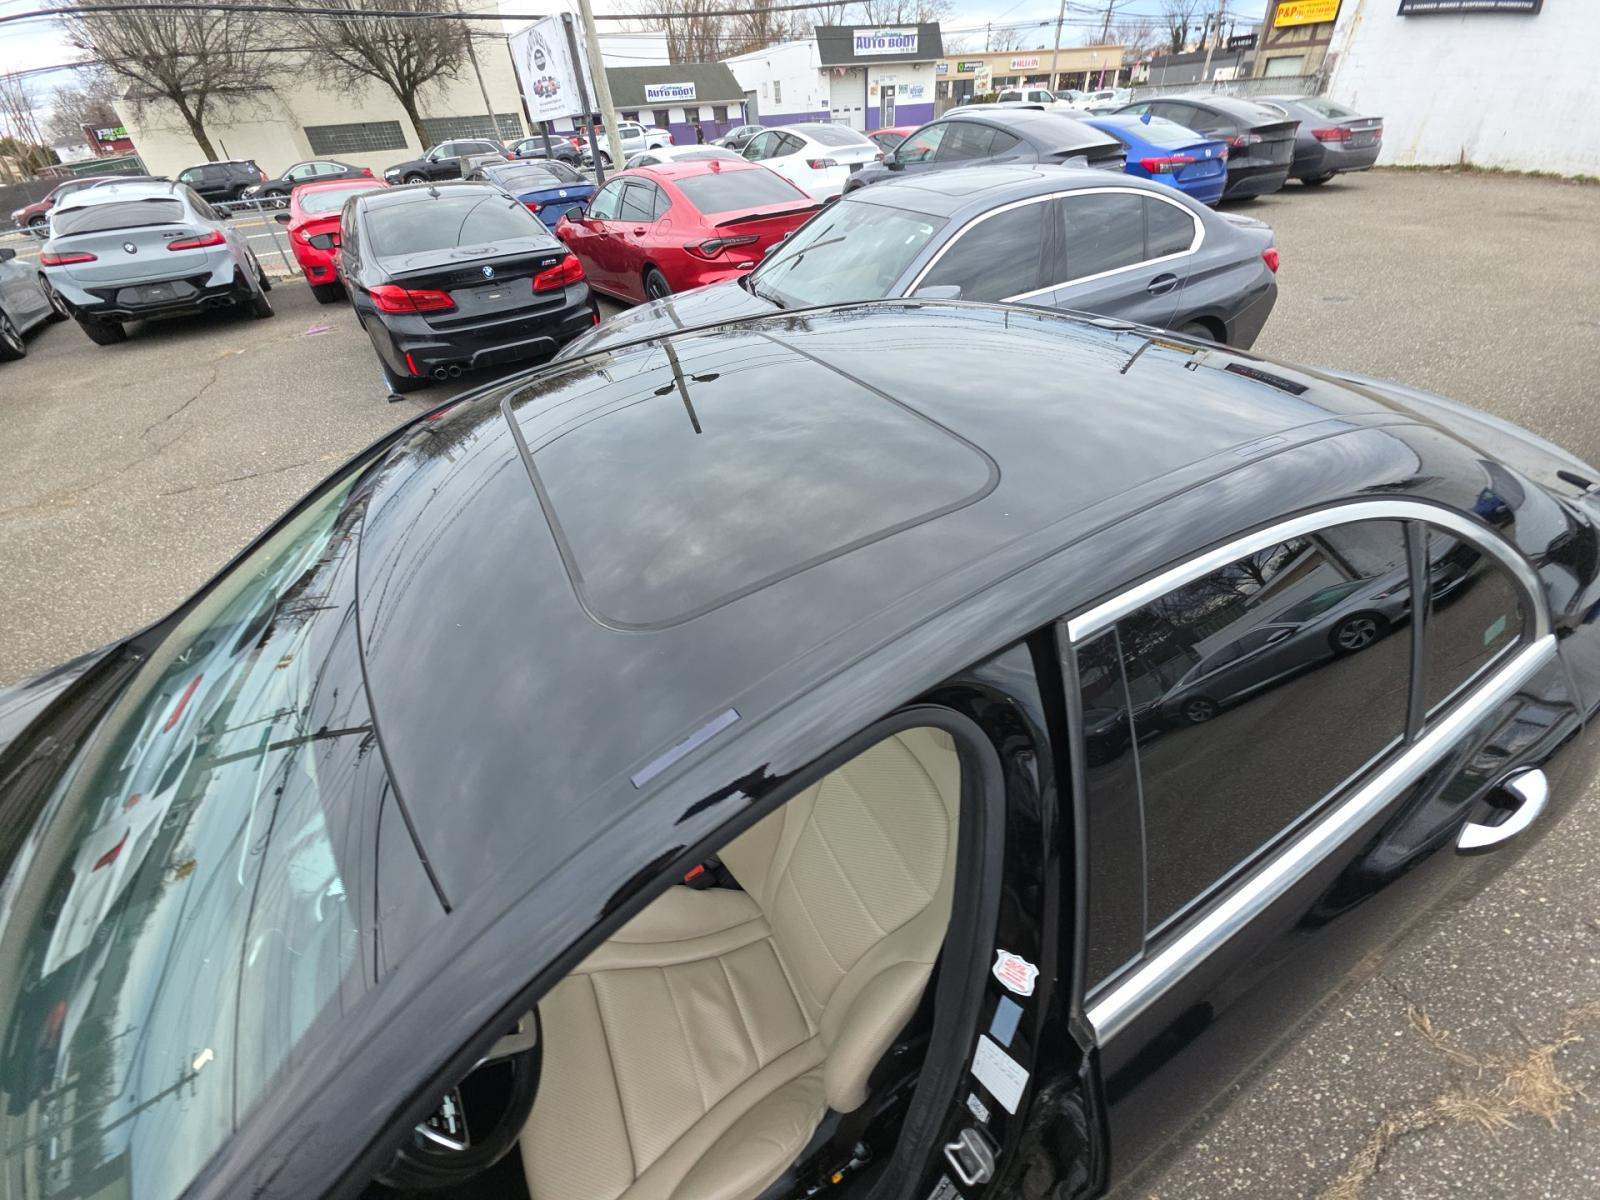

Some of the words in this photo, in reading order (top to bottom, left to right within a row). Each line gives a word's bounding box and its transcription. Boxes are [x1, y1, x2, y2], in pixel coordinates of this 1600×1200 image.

[1277, 6, 1297, 17] P&P
[856, 36, 886, 49] AUTO
[888, 35, 915, 48] BODY
[648, 89, 670, 97] AUTO
[672, 87, 694, 96] BODY
